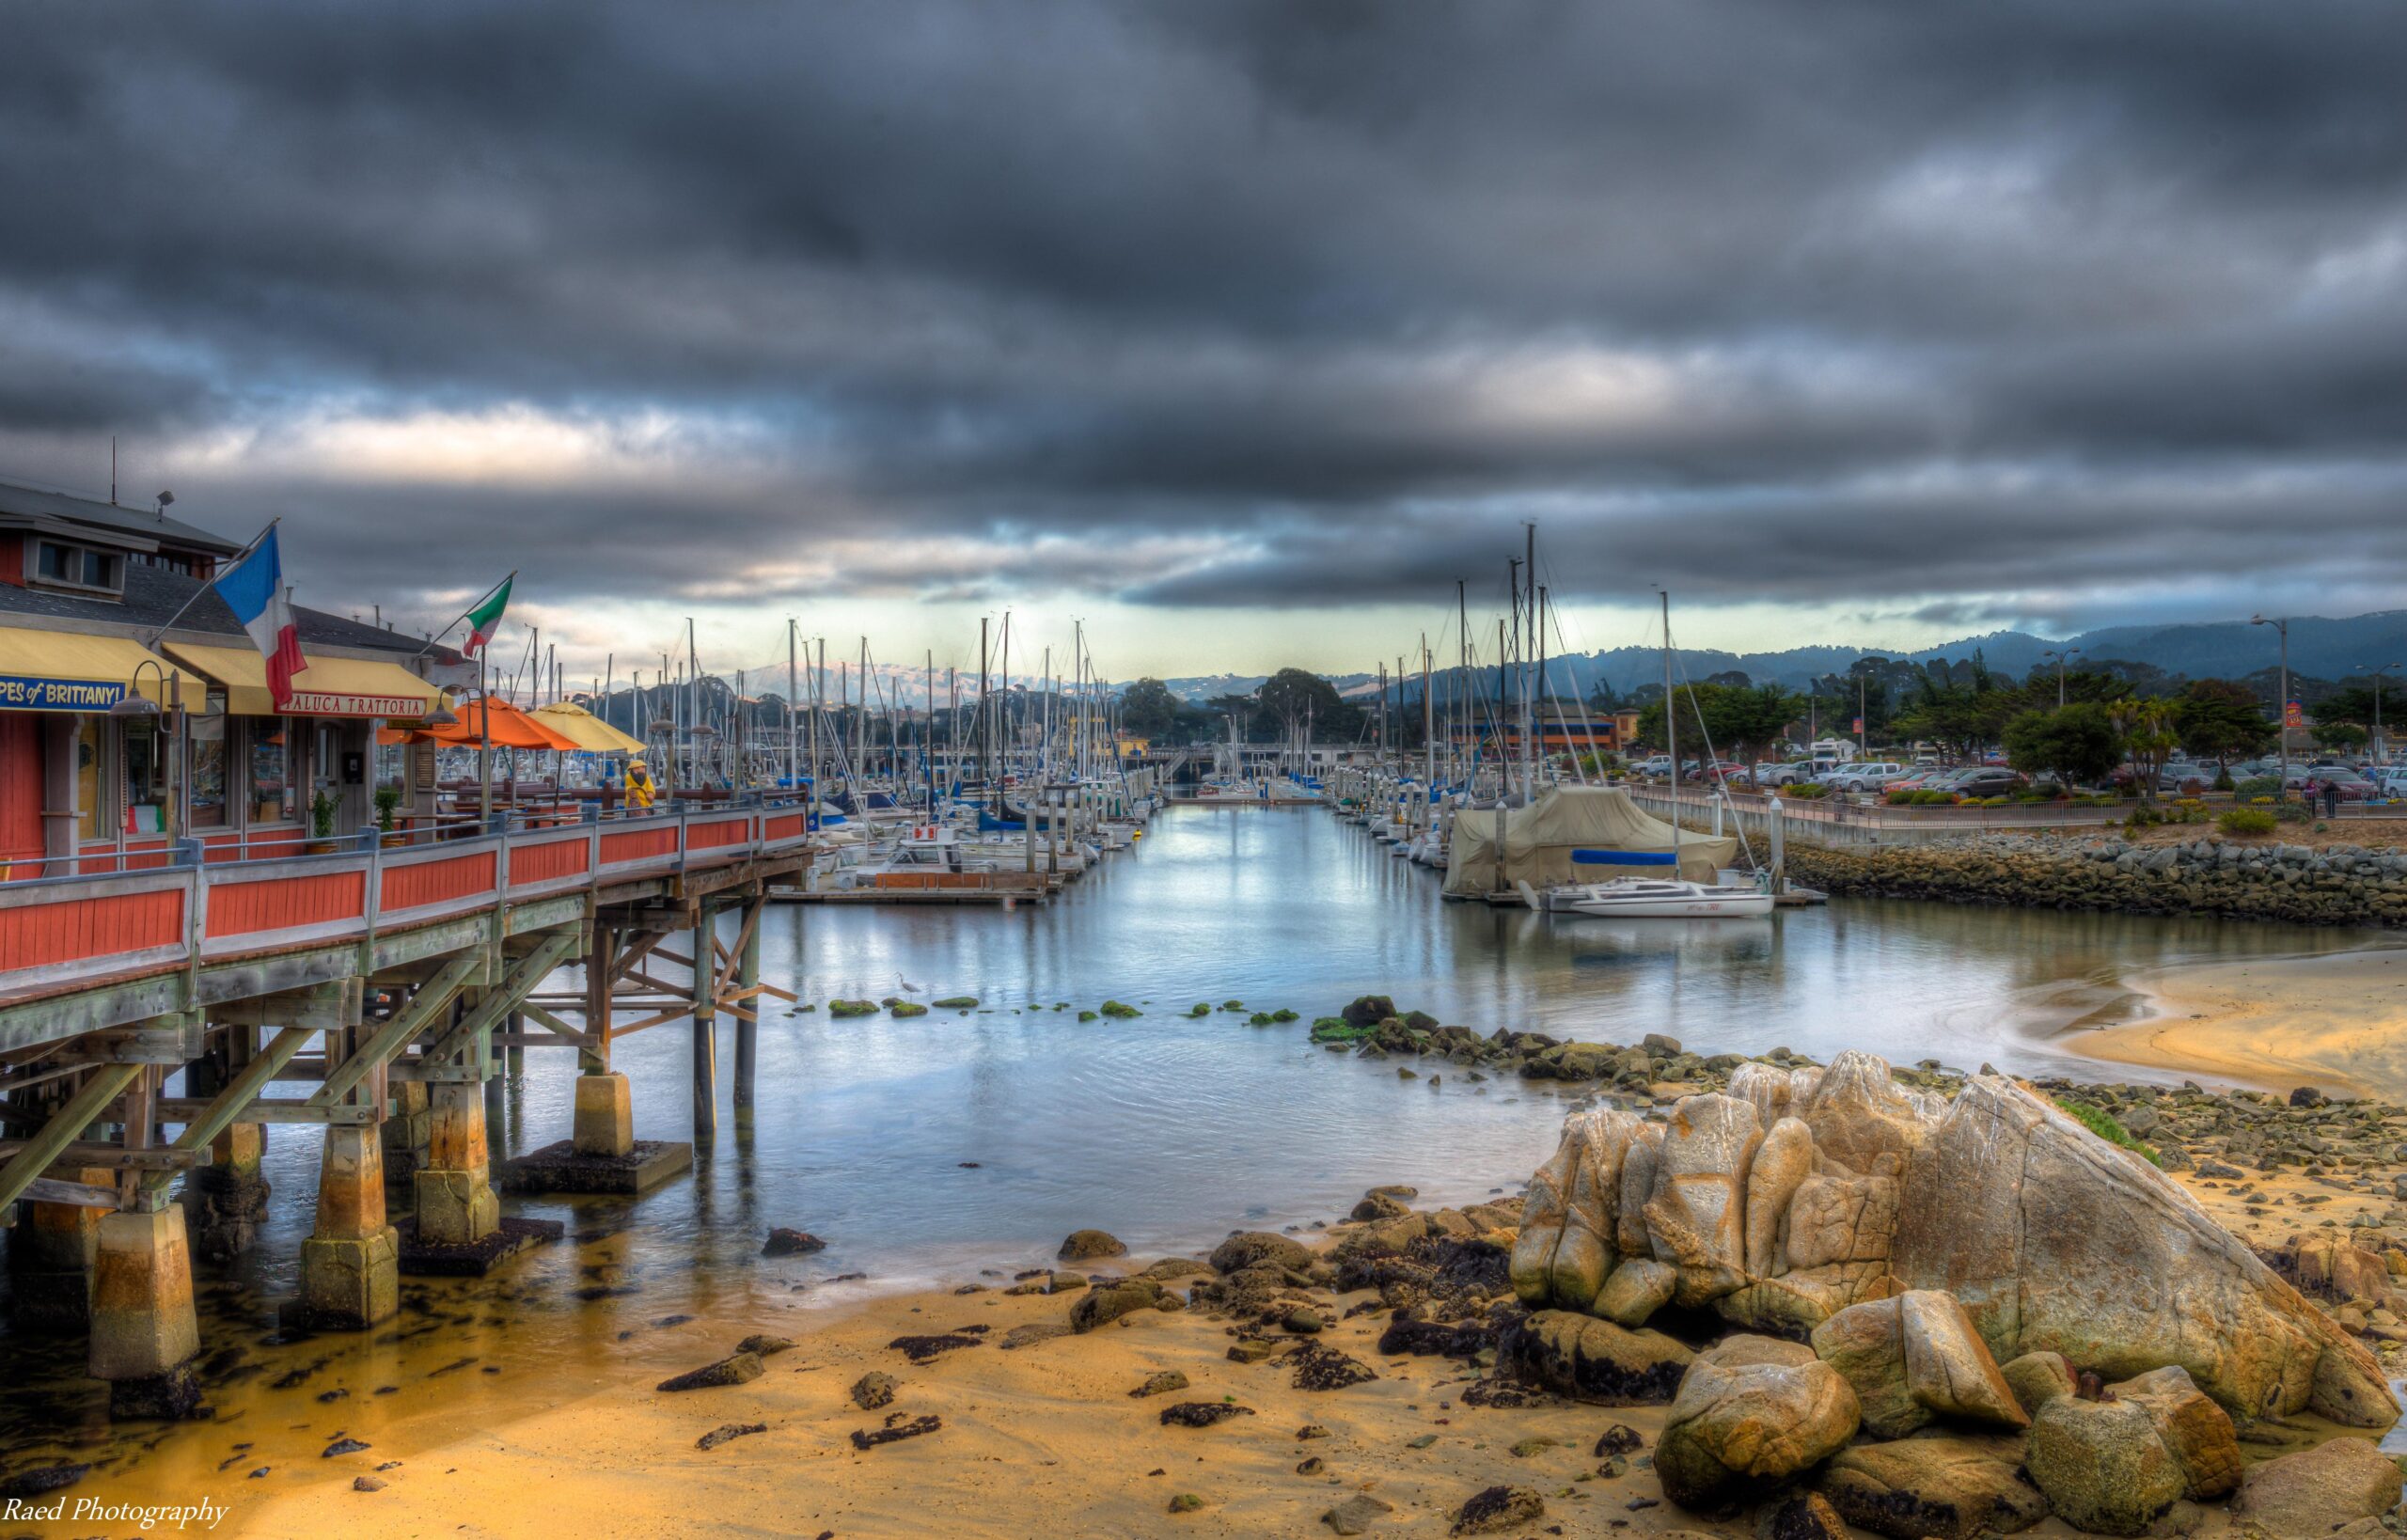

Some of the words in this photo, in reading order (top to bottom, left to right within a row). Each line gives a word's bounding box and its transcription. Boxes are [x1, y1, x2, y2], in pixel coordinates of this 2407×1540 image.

[26, 683, 44, 705] of
[46, 684, 120, 705] BRITTANY!
[348, 698, 419, 715] TRATTORIA
